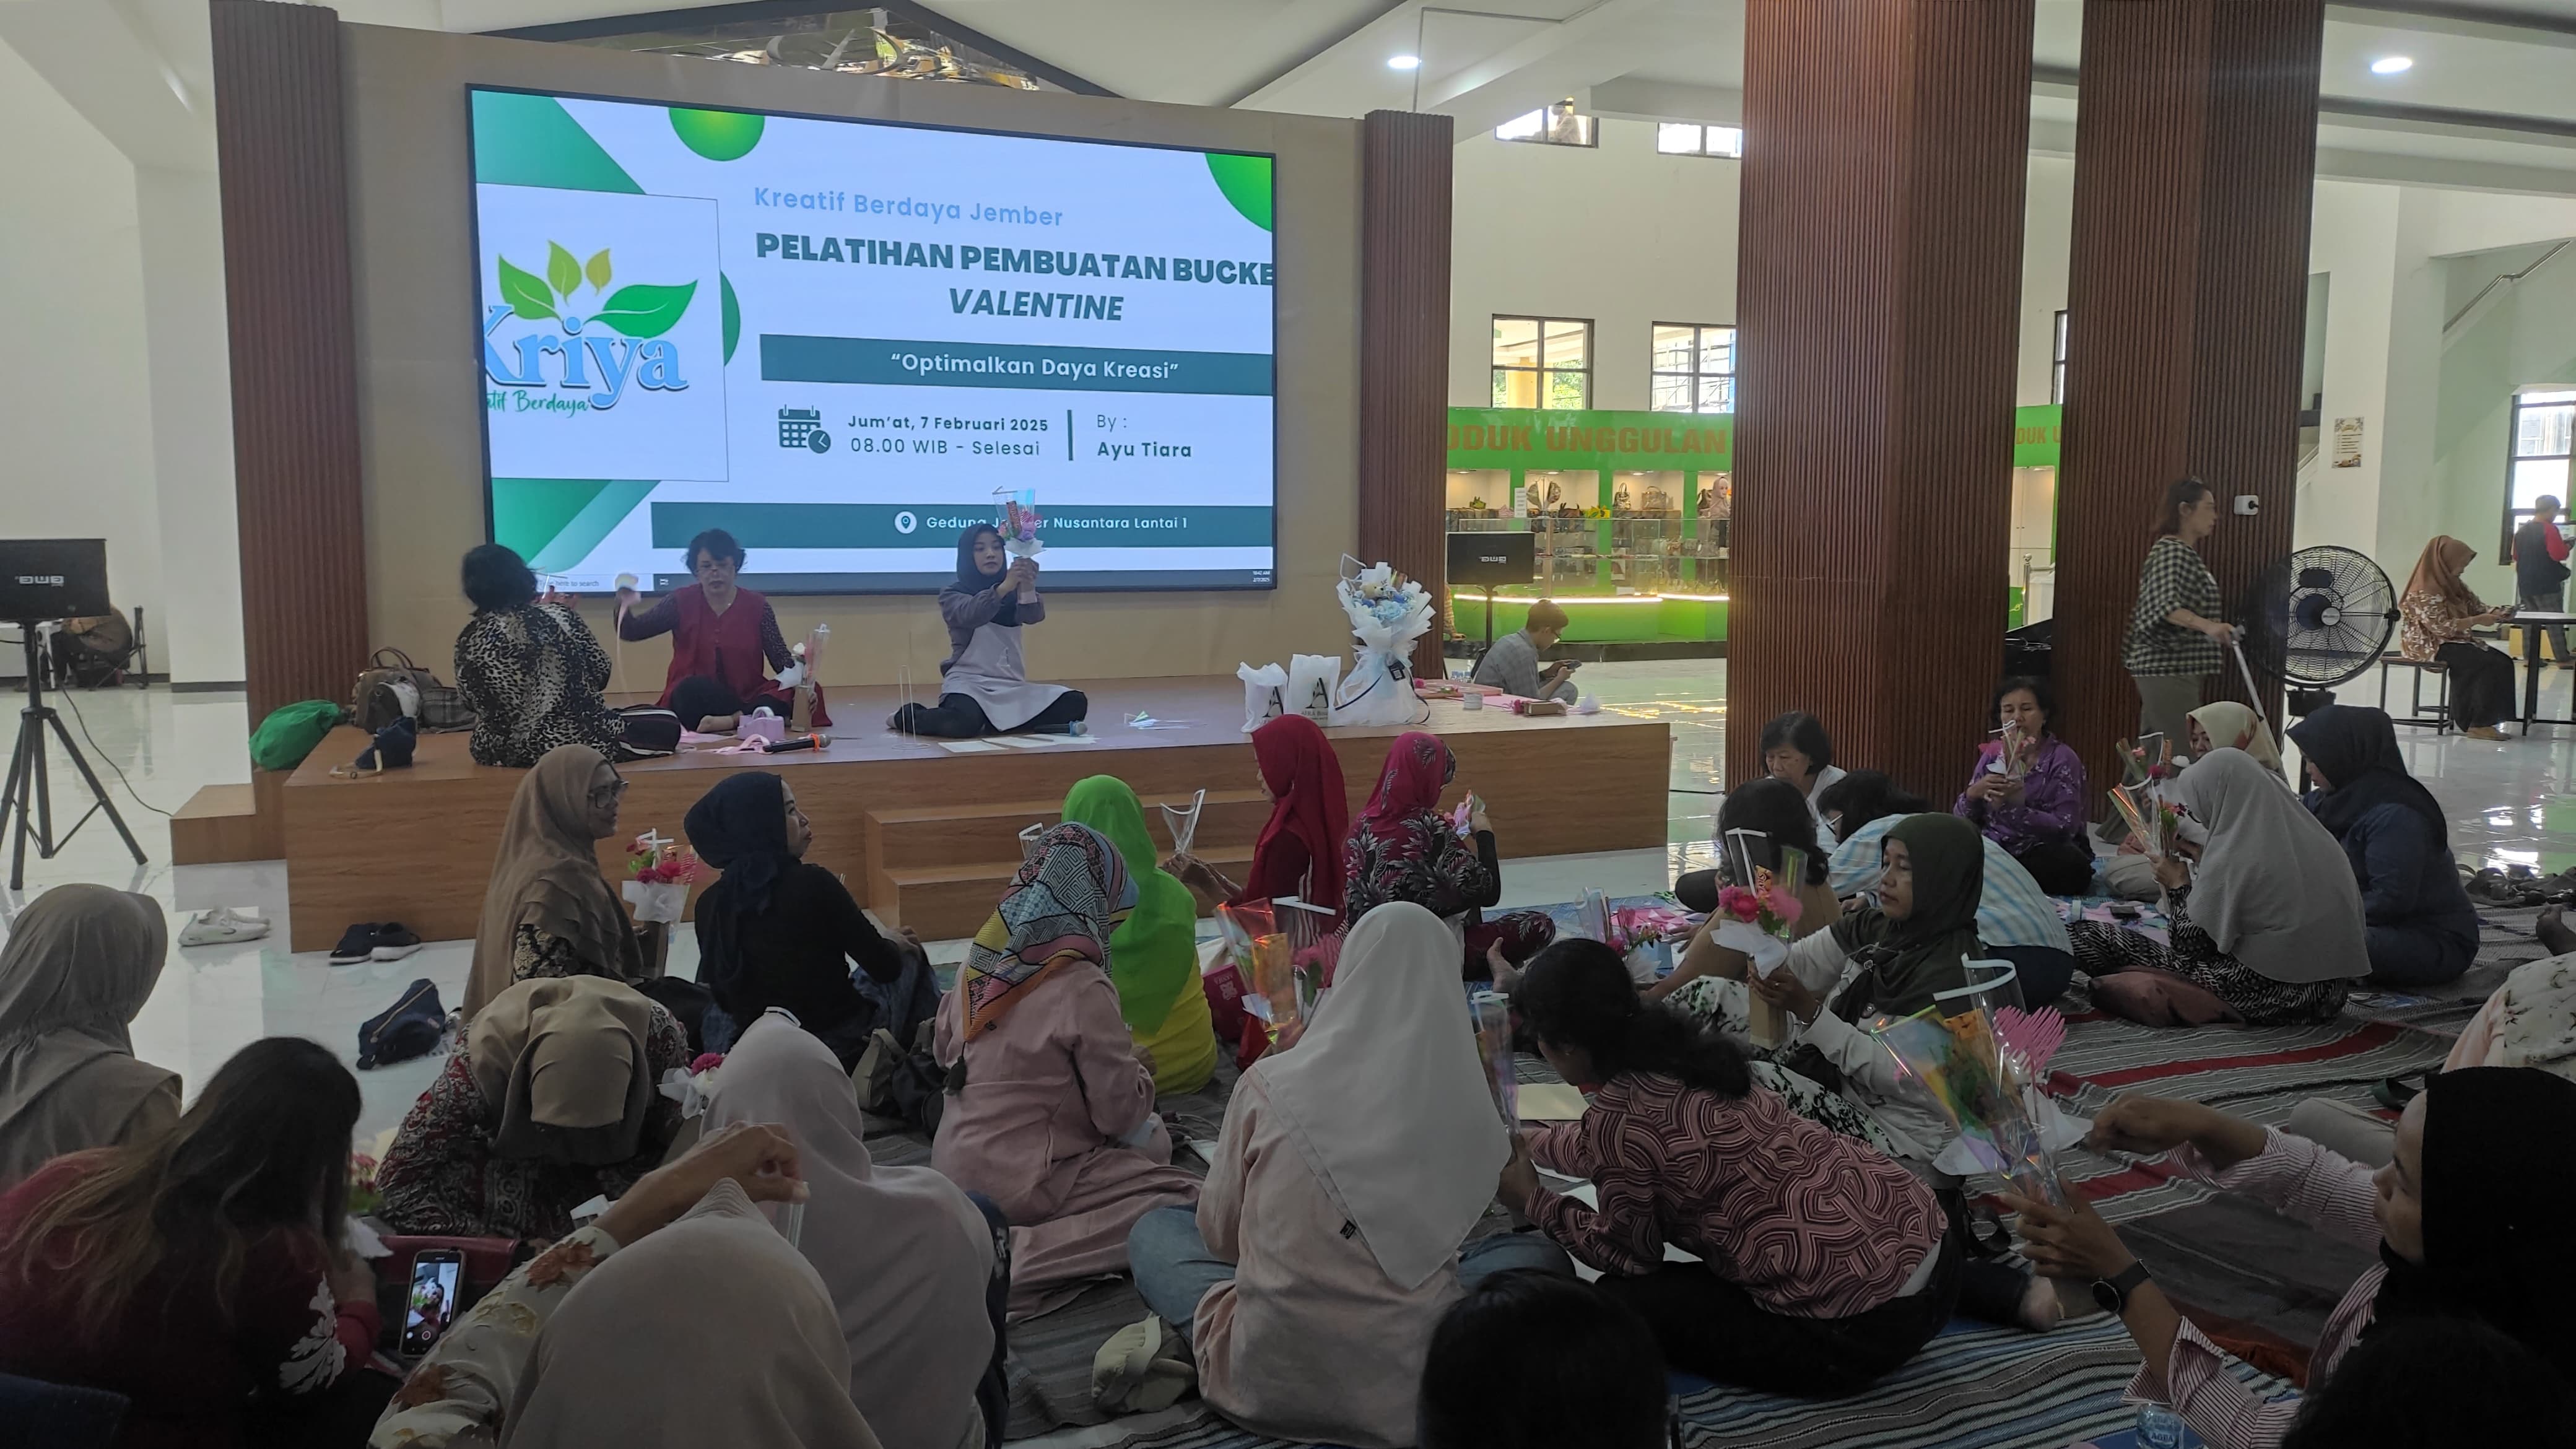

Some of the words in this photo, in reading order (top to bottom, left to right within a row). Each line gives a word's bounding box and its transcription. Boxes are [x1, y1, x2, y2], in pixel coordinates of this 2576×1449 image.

[754, 187, 845, 212] Kreatif
[854, 193, 961, 225] Berdaya
[970, 202, 1064, 226] Jember
[755, 232, 954, 269] PELATIHAN
[960, 245, 1167, 281] PEMBUATAN
[949, 287, 1125, 321] VALENTINE
[1042, 359, 1097, 381] Daya
[512, 389, 589, 419] Berdaya
[920, 416, 929, 429] 7
[934, 417, 1005, 432] Februari
[1010, 419, 1048, 432] 2025
[1097, 414, 1117, 432] By
[850, 438, 905, 453] 08.00
[912, 440, 947, 455] WIB
[972, 440, 1040, 456] Selesai
[1544, 425, 1726, 454] UNGGULAN
[1097, 442, 1134, 462] Ayu
[1142, 441, 1192, 458] Tiara
[1053, 517, 1129, 529] Nusantara
[1134, 517, 1178, 529] Lantai
[1181, 517, 1188, 529] 1
[579, 579, 599, 587] search
